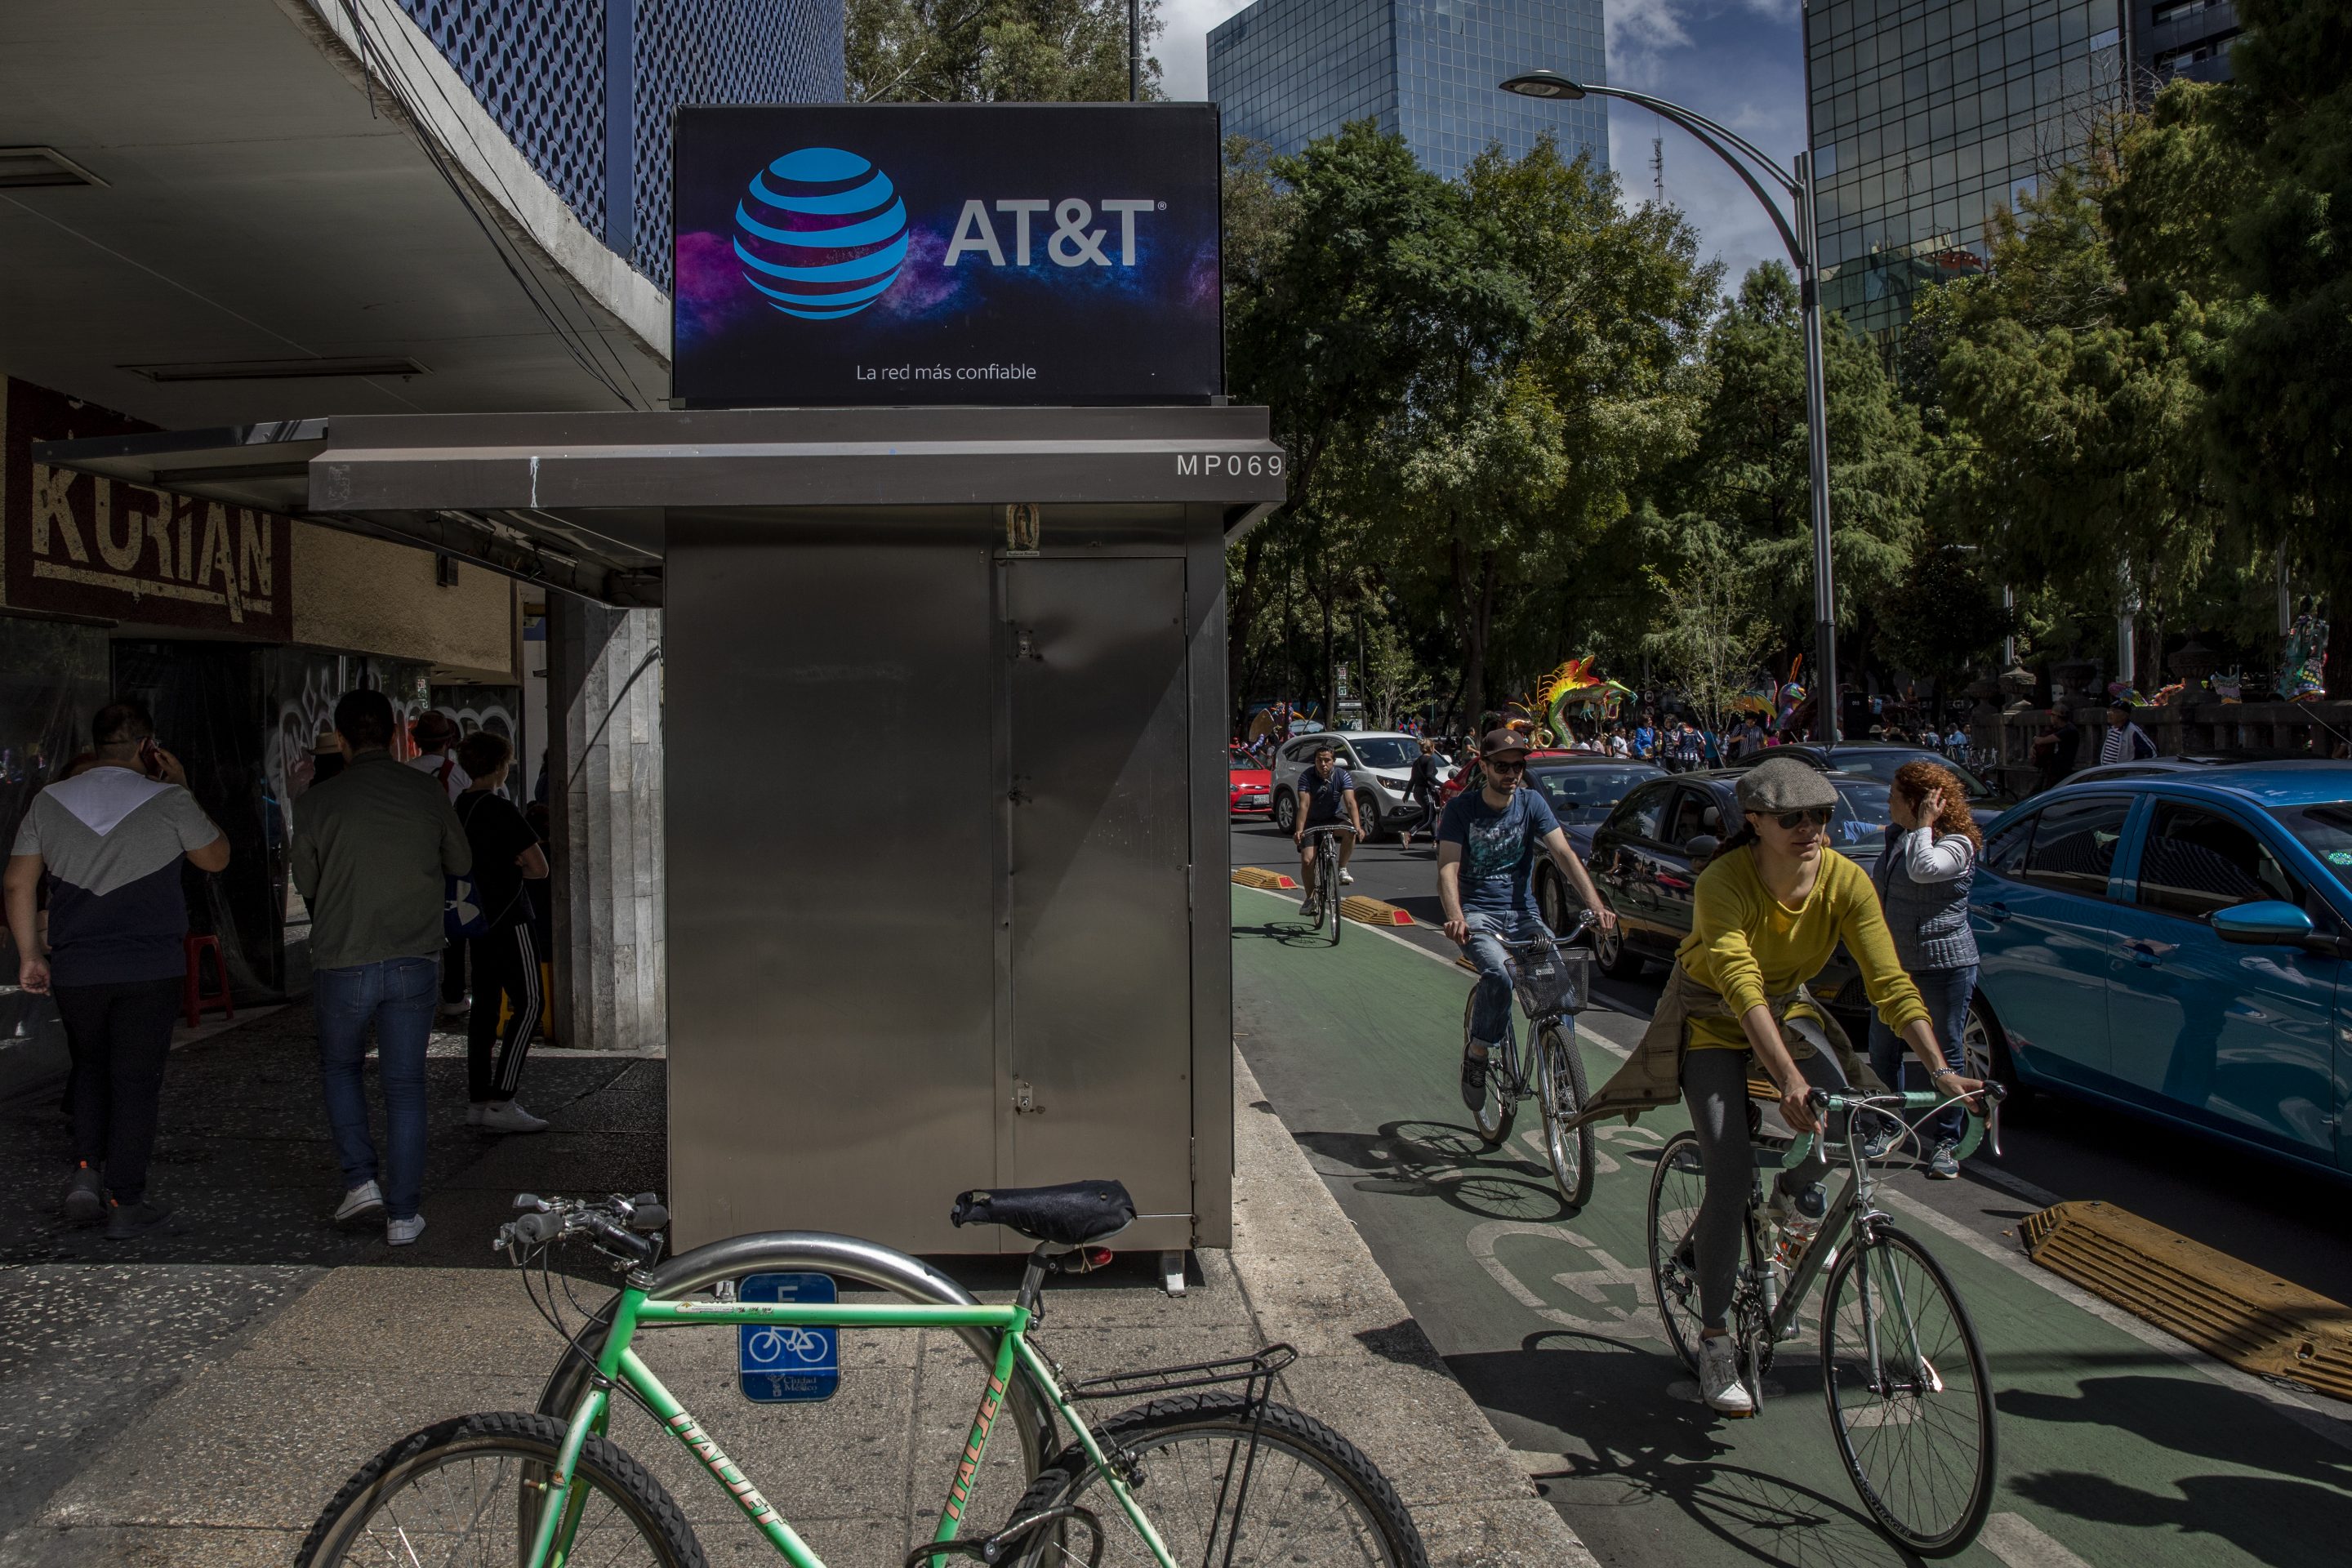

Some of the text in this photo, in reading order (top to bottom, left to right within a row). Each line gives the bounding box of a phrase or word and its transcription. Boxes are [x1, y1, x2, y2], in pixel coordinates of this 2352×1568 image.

[857, 363, 1036, 380] La red más confiable
[1177, 454, 1282, 476] MP069
[783, 1376, 817, 1384] Ciudad
[944, 1365, 1004, 1521] ITALJET
[668, 1412, 785, 1525] ITALJET
